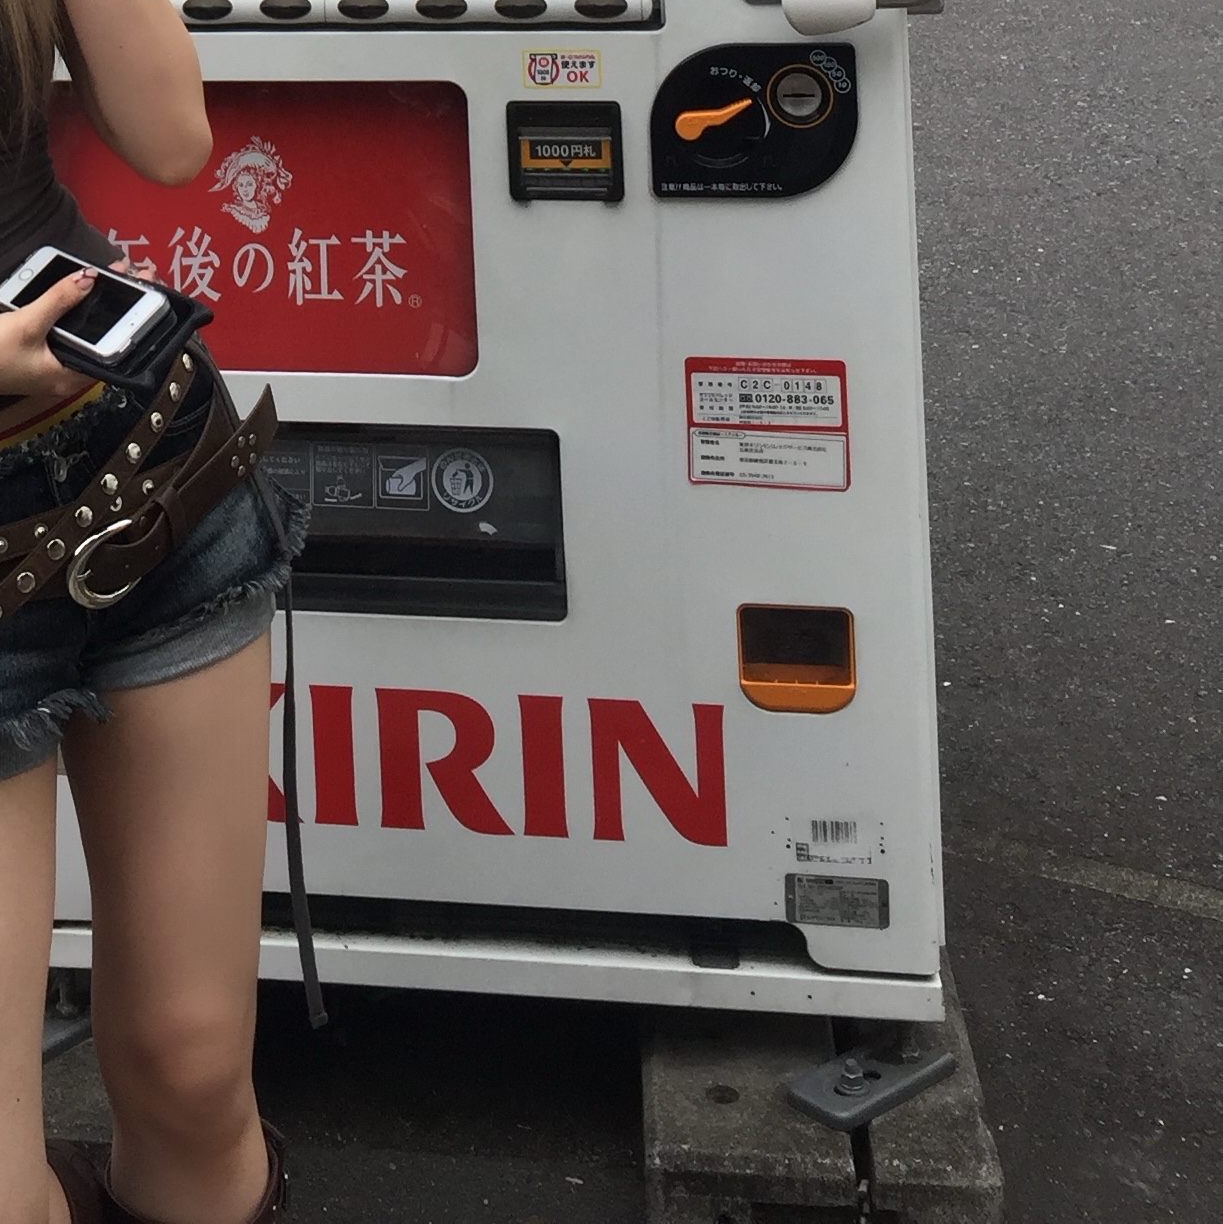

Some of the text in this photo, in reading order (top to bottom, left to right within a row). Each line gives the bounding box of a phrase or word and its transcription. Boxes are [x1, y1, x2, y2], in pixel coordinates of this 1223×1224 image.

[561, 60, 596, 69] 使えます
[566, 70, 590, 83] OK
[535, 143, 597, 158] 1000円札
